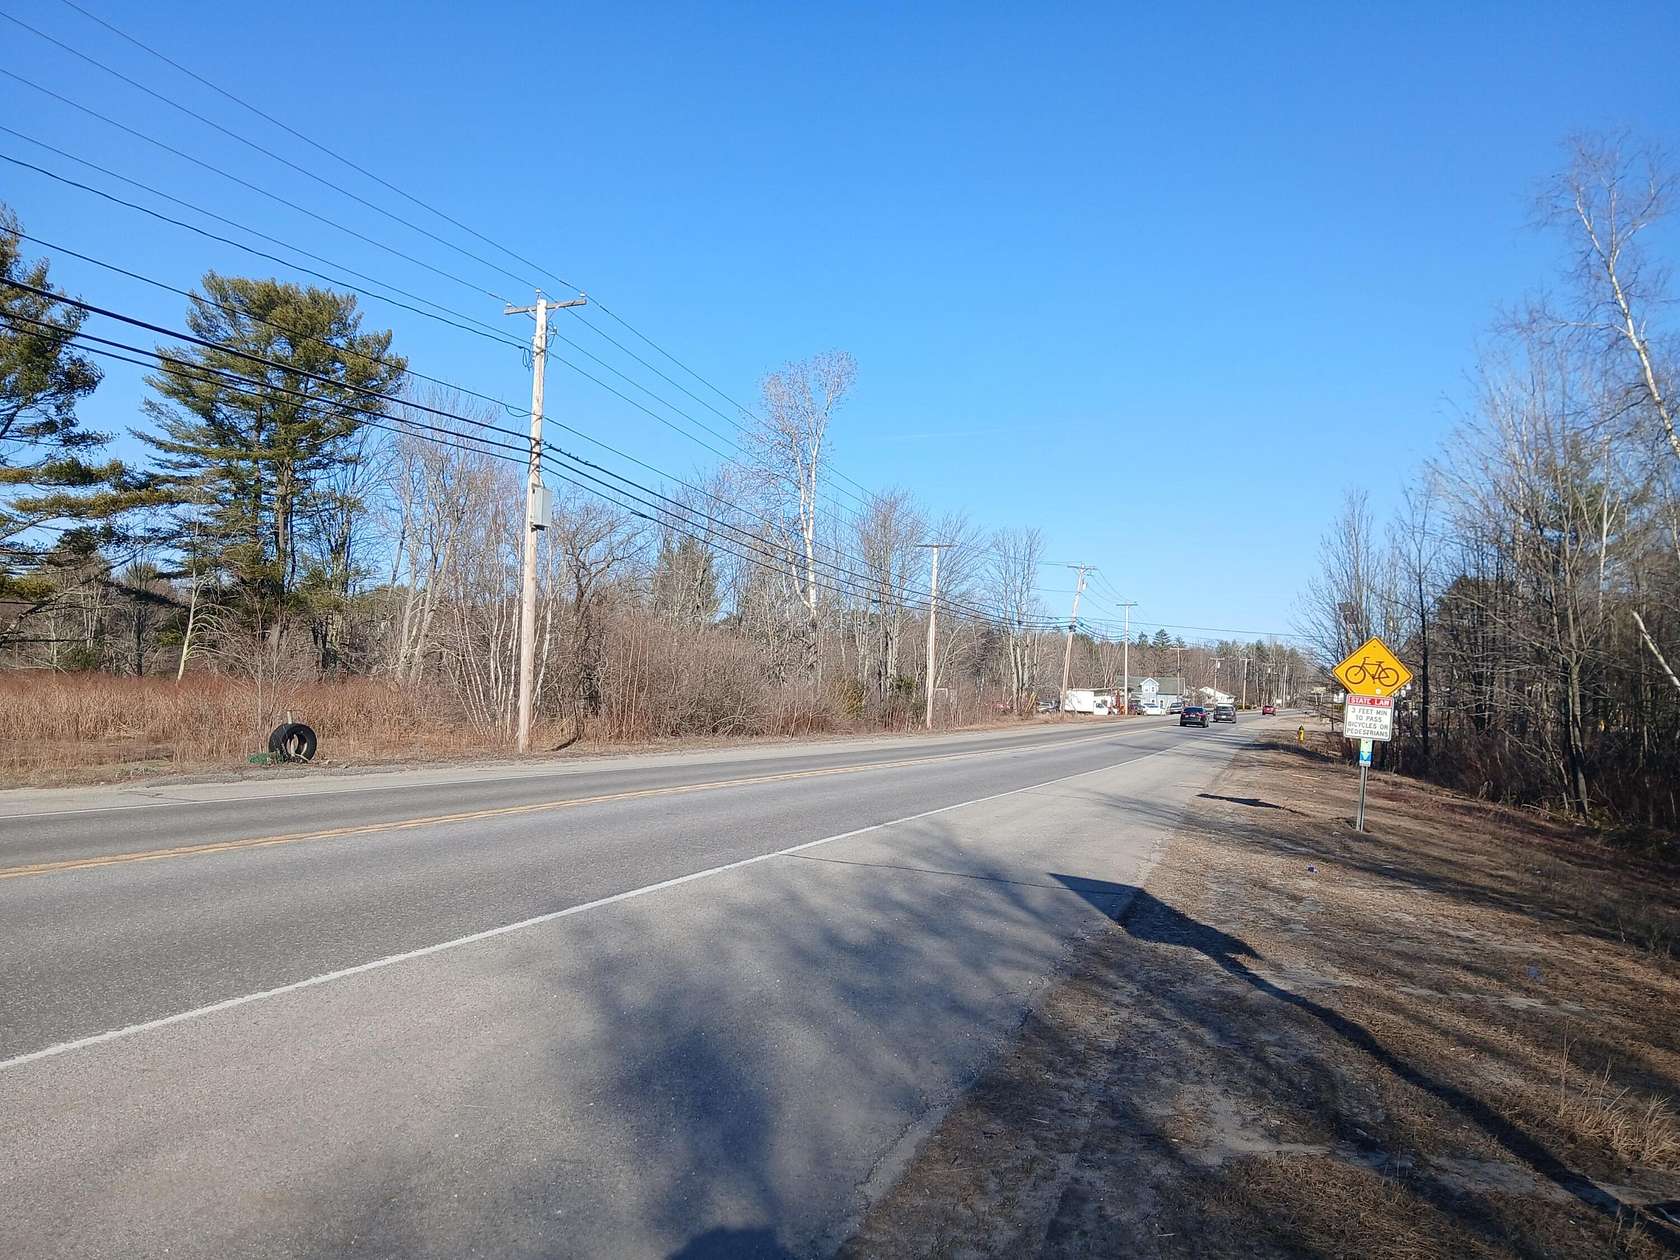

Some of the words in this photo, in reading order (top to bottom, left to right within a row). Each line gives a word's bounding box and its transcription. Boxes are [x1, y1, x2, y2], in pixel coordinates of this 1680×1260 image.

[1375, 698, 1390, 706] LAW
[1348, 721, 1376, 729] BICYCLES
[1347, 728, 1388, 737] PEDESTRIANS
